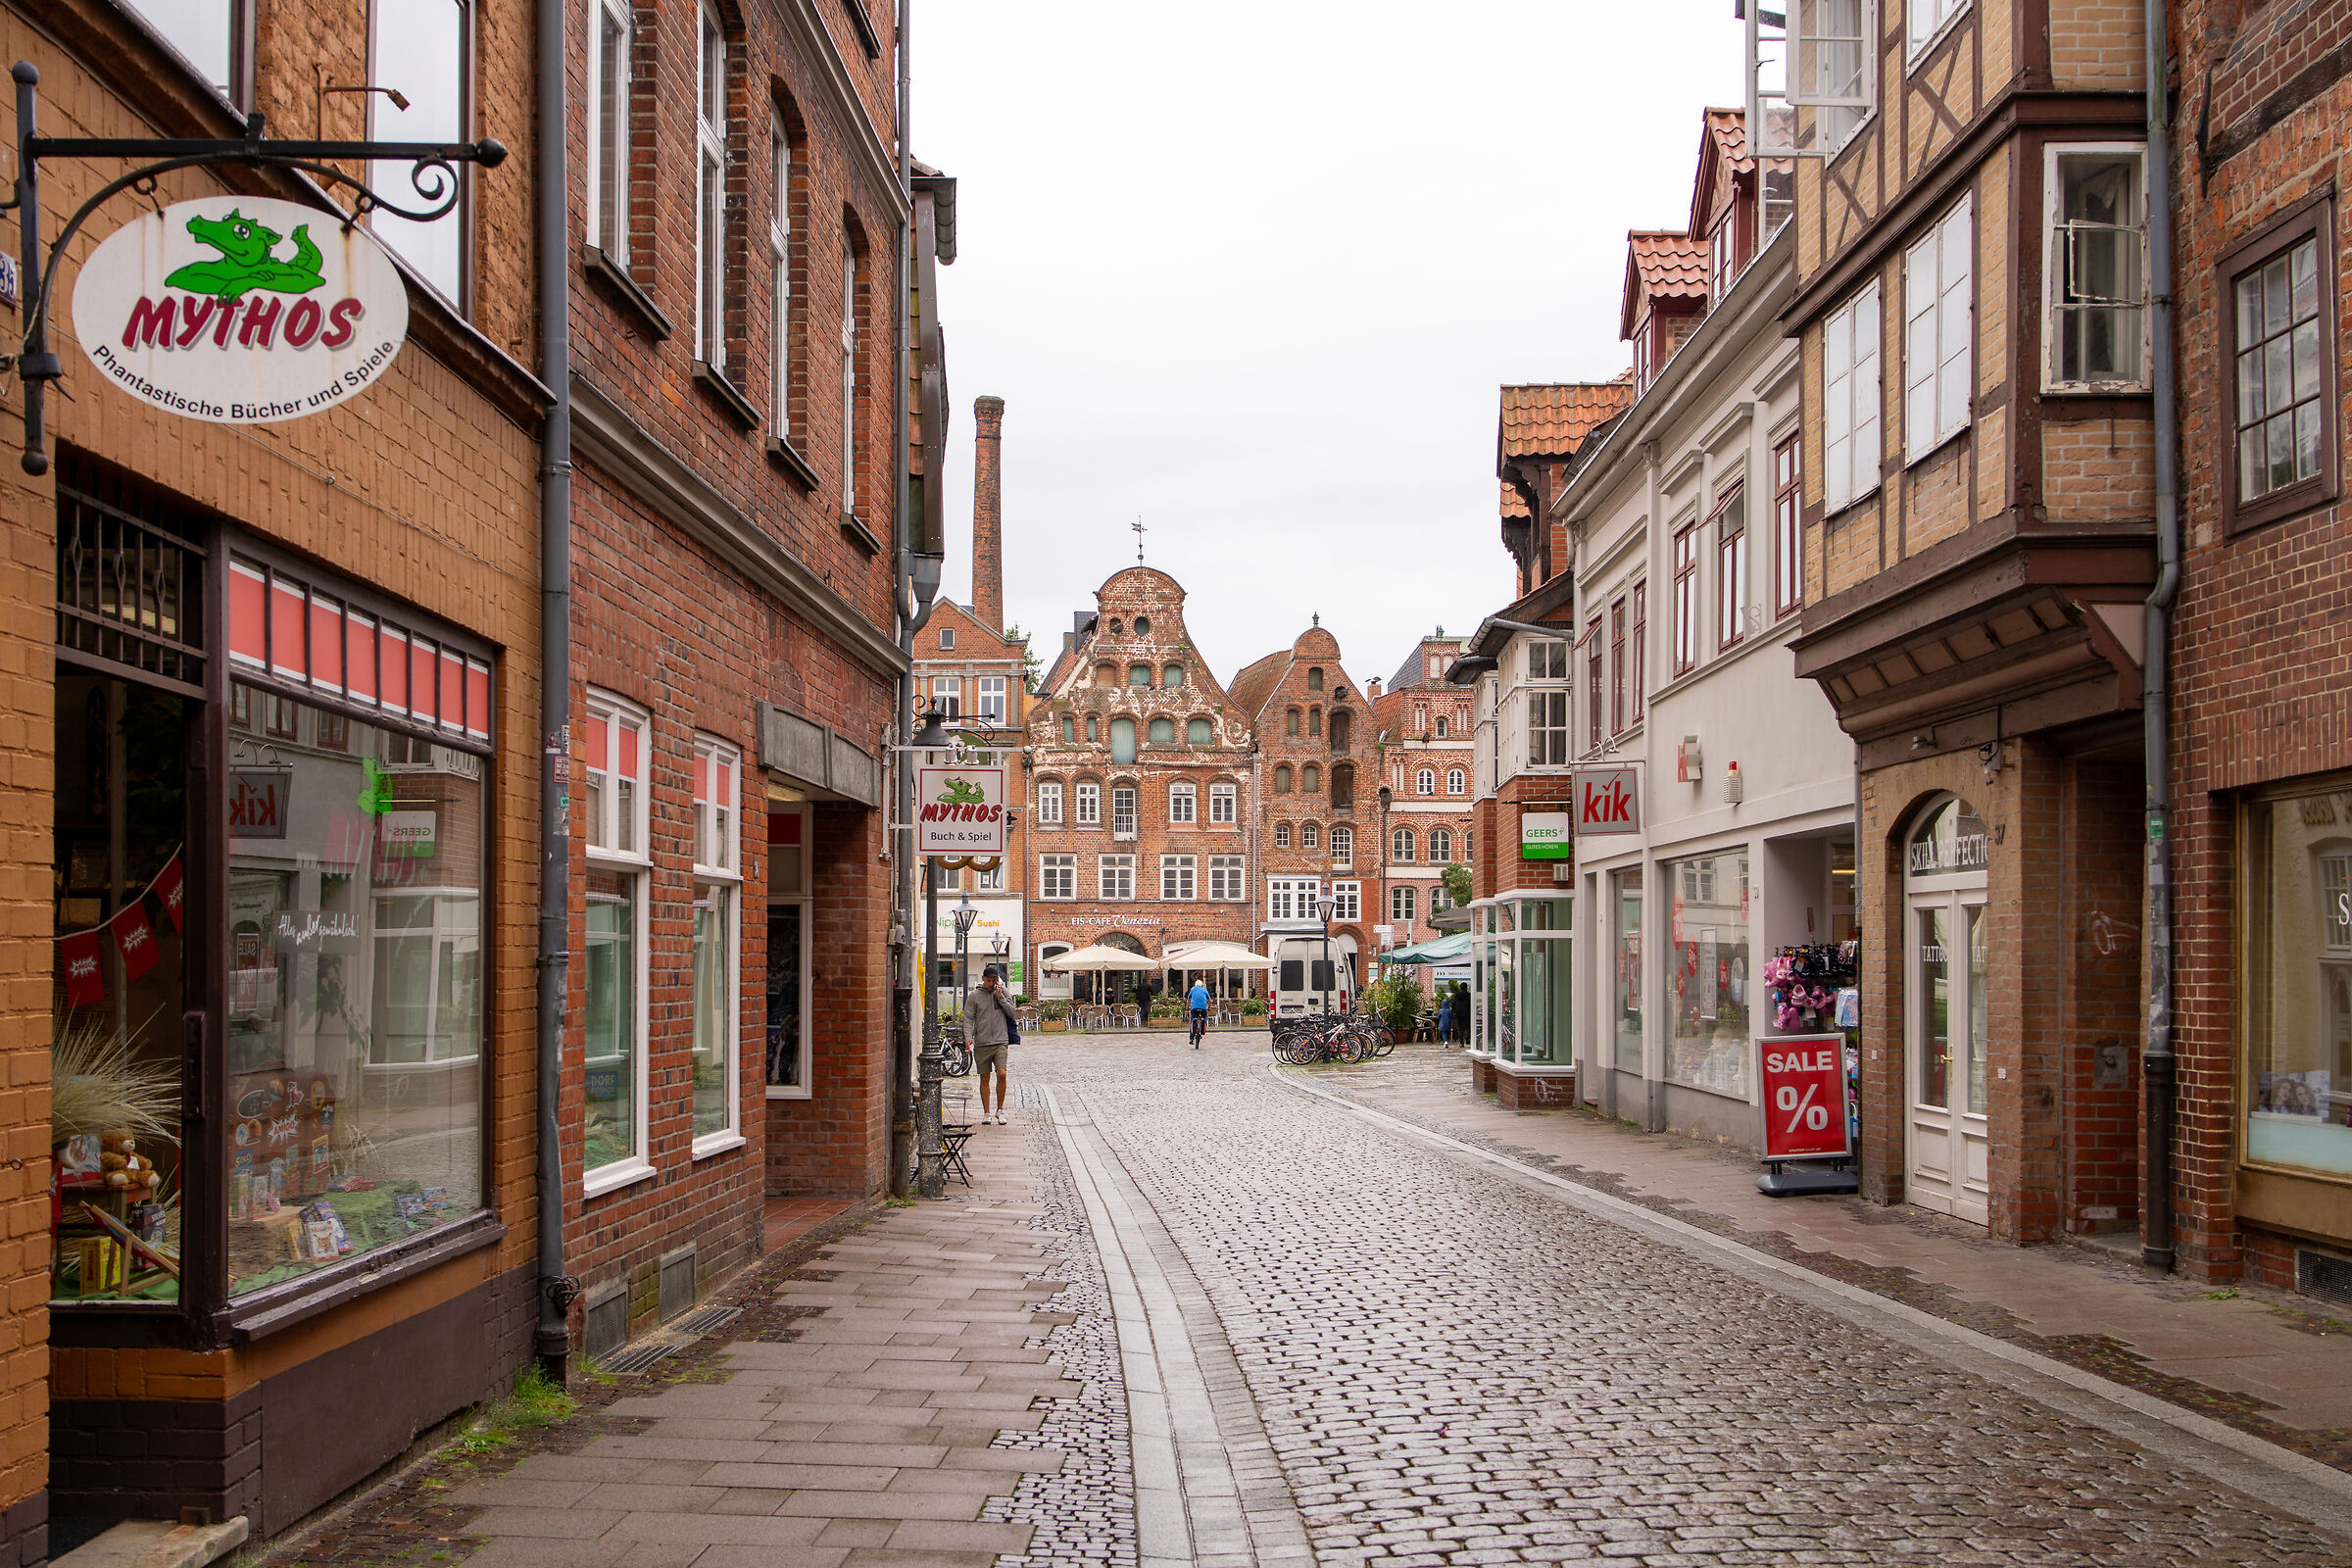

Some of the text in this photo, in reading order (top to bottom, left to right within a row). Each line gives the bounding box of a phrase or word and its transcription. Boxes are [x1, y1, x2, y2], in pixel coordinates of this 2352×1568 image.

[122, 296, 364, 350] MYTHOS
[93, 341, 393, 419] Phantastische Bücher und Spiele
[919, 804, 1003, 822] MYTHOS
[930, 832, 992, 842] Buch & Spiel
[1526, 829, 1558, 838] GEERS
[1995, 824, 2006, 846] 37
[1912, 841, 1936, 871] SKILL
[1112, 914, 1160, 927] Venezia
[1767, 1051, 1834, 1073] SALE
[1776, 1083, 1829, 1134] %
[273, 1120, 295, 1135] AMIGO
